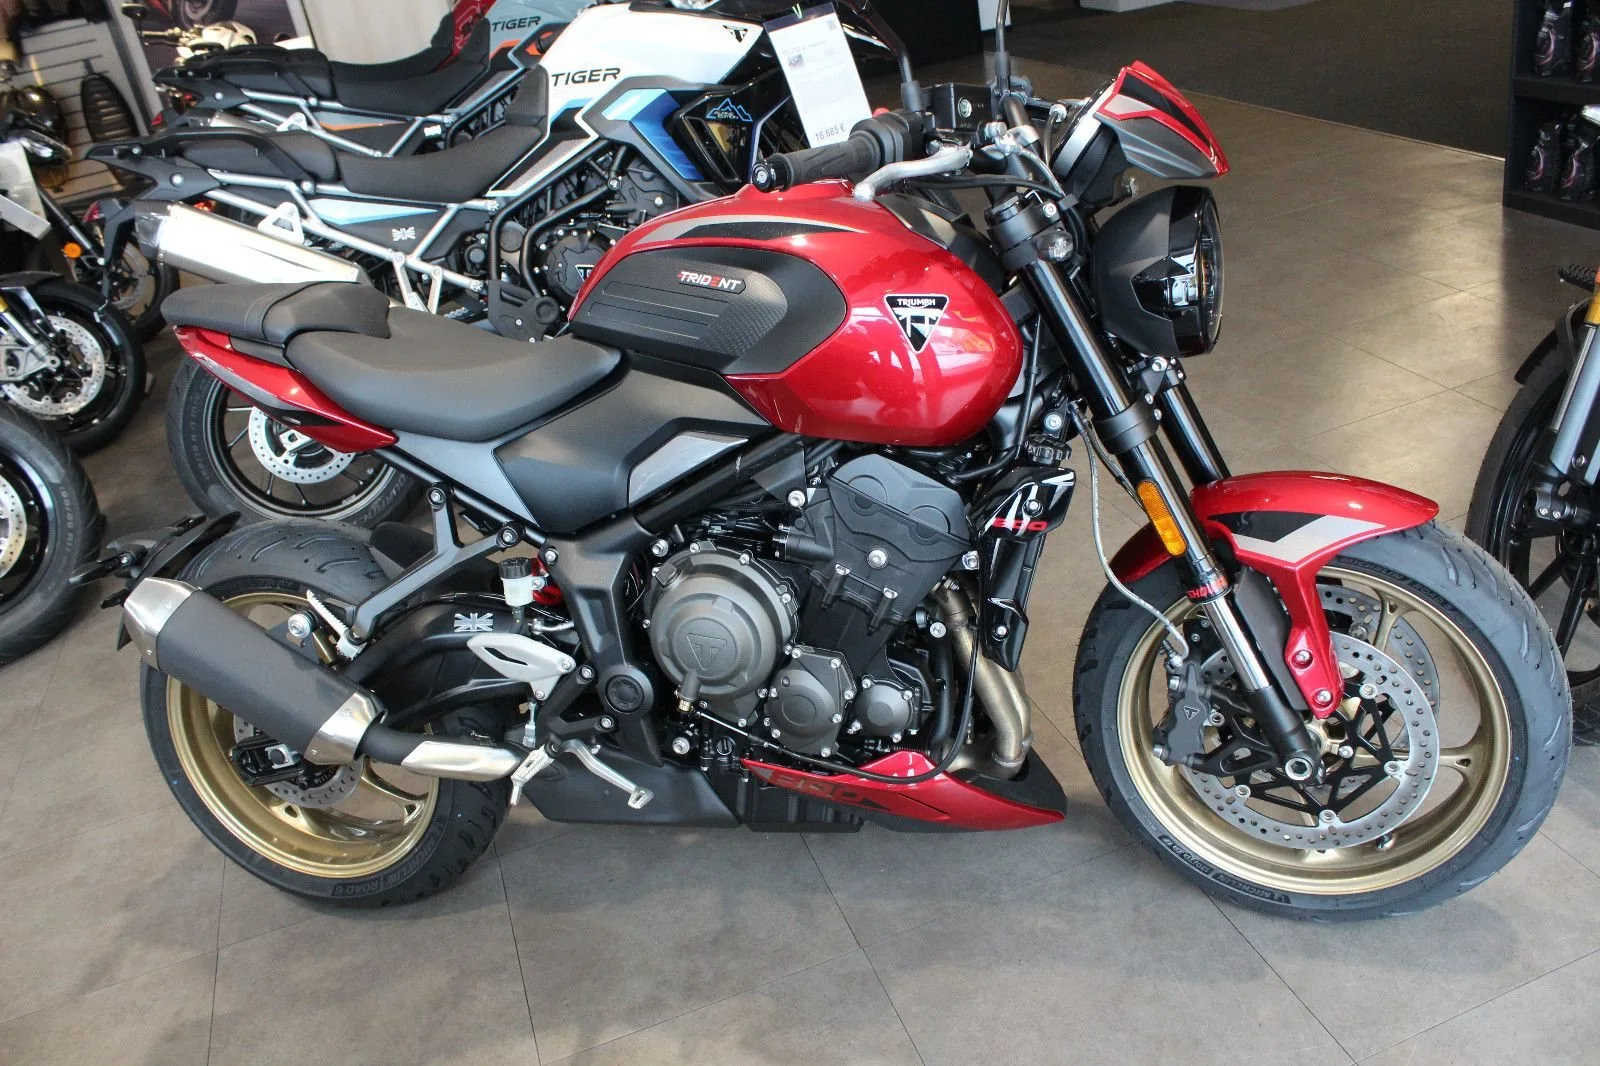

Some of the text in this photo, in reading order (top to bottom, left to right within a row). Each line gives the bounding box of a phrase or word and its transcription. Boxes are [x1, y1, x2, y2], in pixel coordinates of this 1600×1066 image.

[491, 16, 541, 32] TIGER
[552, 67, 621, 87] TIGER
[679, 271, 742, 290] TRIDENT
[896, 298, 936, 306] TRIUMPH
[346, 880, 379, 894] ROAD
[1218, 873, 1273, 898] MICHELIN
